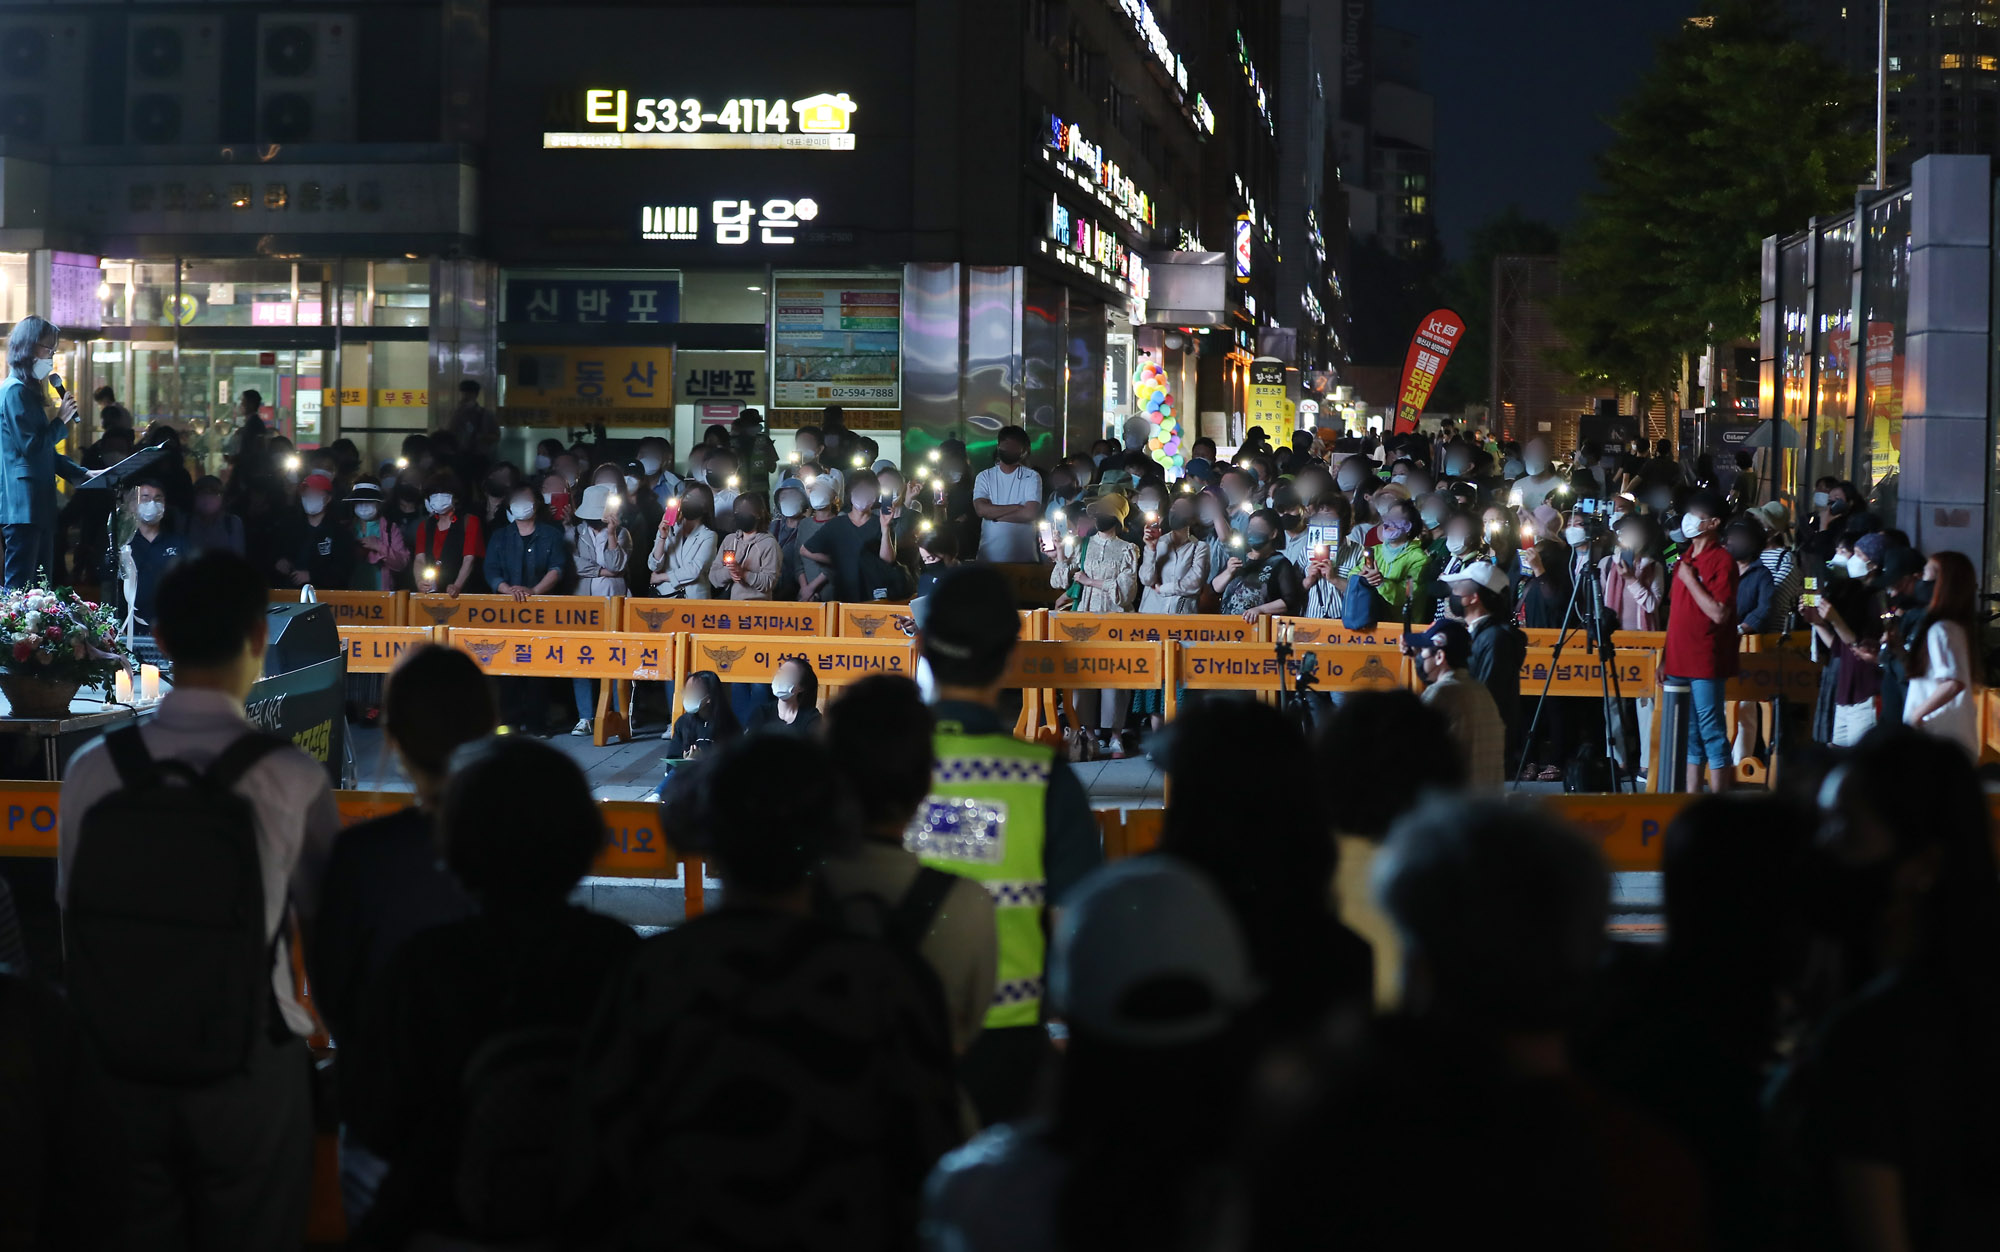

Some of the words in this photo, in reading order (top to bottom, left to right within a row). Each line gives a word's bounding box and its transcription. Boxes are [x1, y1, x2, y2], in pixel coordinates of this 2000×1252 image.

[633, 98, 790, 133] 533-4114
[712, 199, 799, 245] 담은
[526, 287, 659, 323] 신반포
[1428, 318, 1443, 335] kt
[1415, 350, 1440, 375] 필름
[685, 369, 756, 396] 신반포
[1409, 367, 1434, 392] 무료
[831, 388, 894, 398] 02-594-7888
[1402, 385, 1427, 410] 교체
[468, 607, 544, 624] POLICE
[555, 608, 599, 625] LINE
[681, 613, 695, 629] 이
[702, 613, 731, 630] 선을
[738, 614, 815, 631] 넘지마시오
[1108, 628, 1123, 642] 이
[374, 641, 410, 658] LIN
[754, 652, 769, 668] 이
[817, 653, 904, 672] 넘지마시오
[1063, 657, 1150, 675] 넘지마시오
[1556, 664, 1643, 682] 넘지마시오
